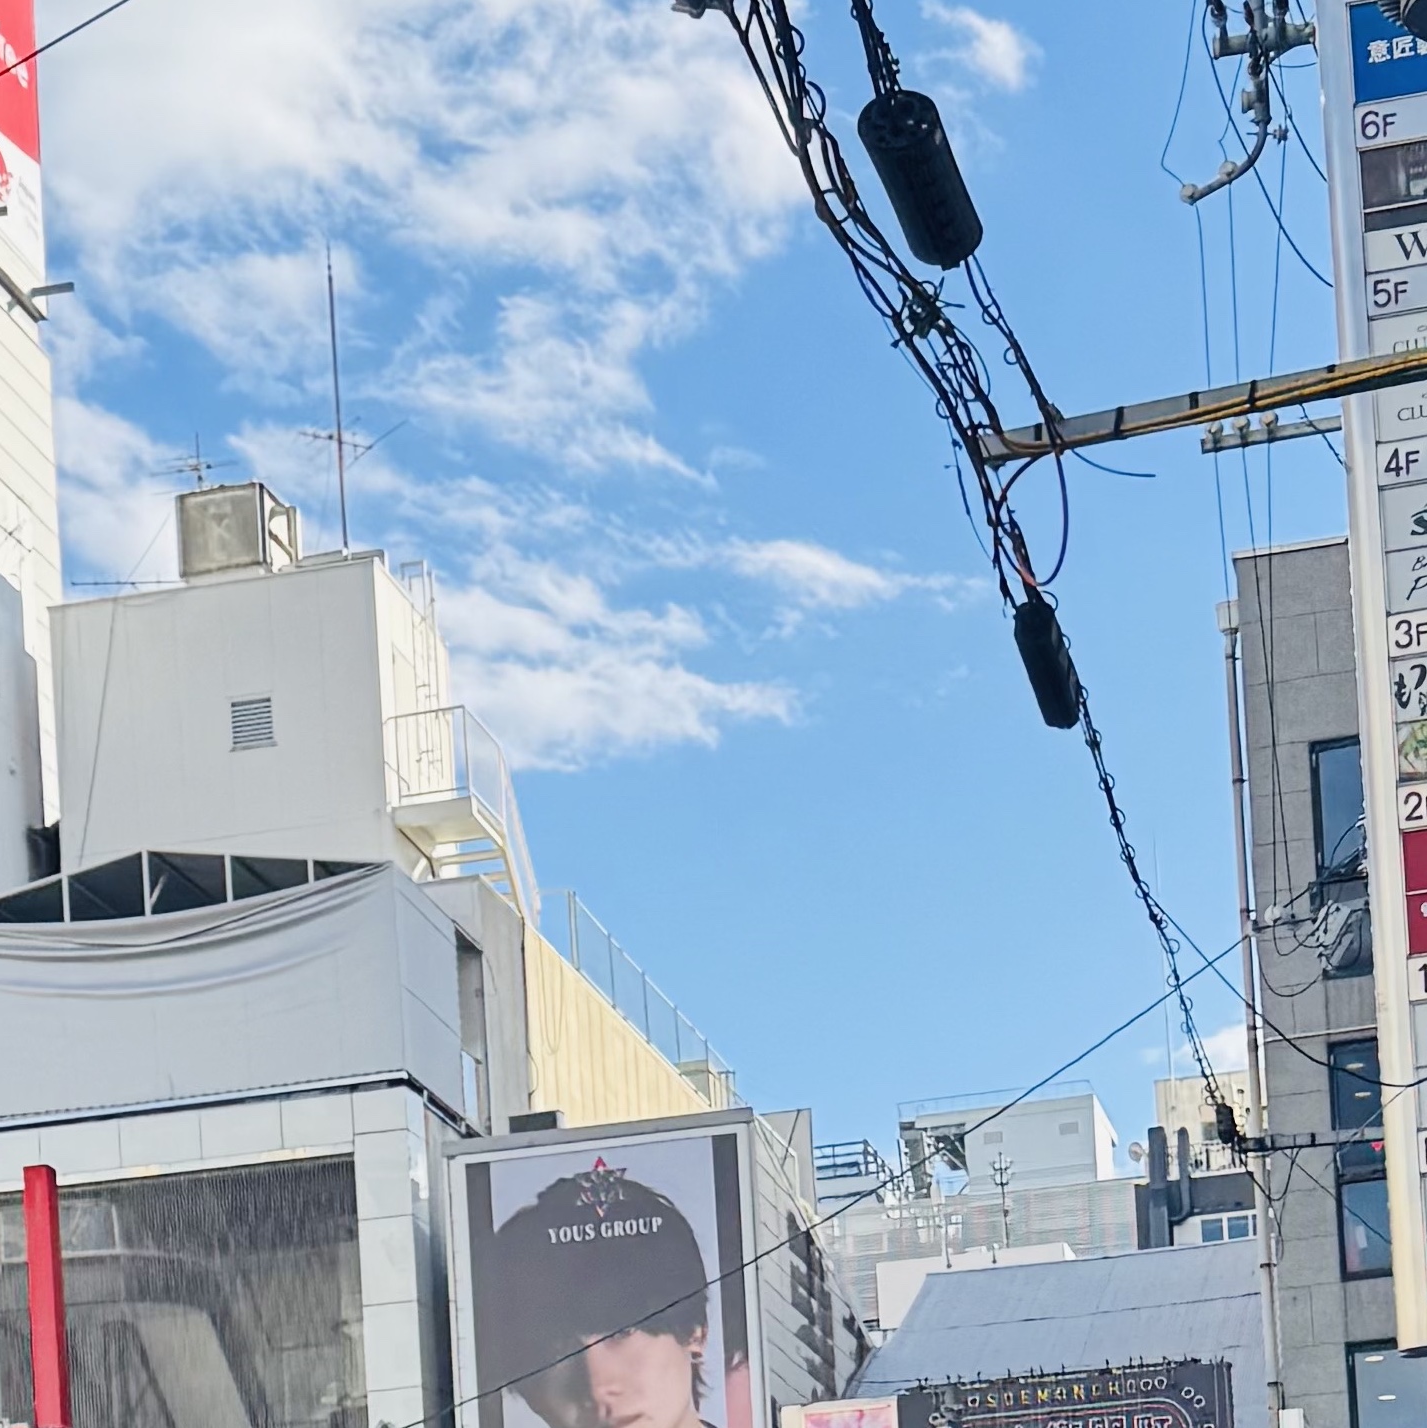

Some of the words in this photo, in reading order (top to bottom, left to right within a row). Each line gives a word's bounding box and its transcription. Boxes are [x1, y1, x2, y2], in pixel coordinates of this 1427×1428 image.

[1360, 110, 1397, 140] 6F
[1373, 279, 1409, 308] 5F
[1384, 447, 1420, 477] 4F
[548, 1223, 596, 1244] YOUS
[600, 1216, 663, 1239] GROUP
